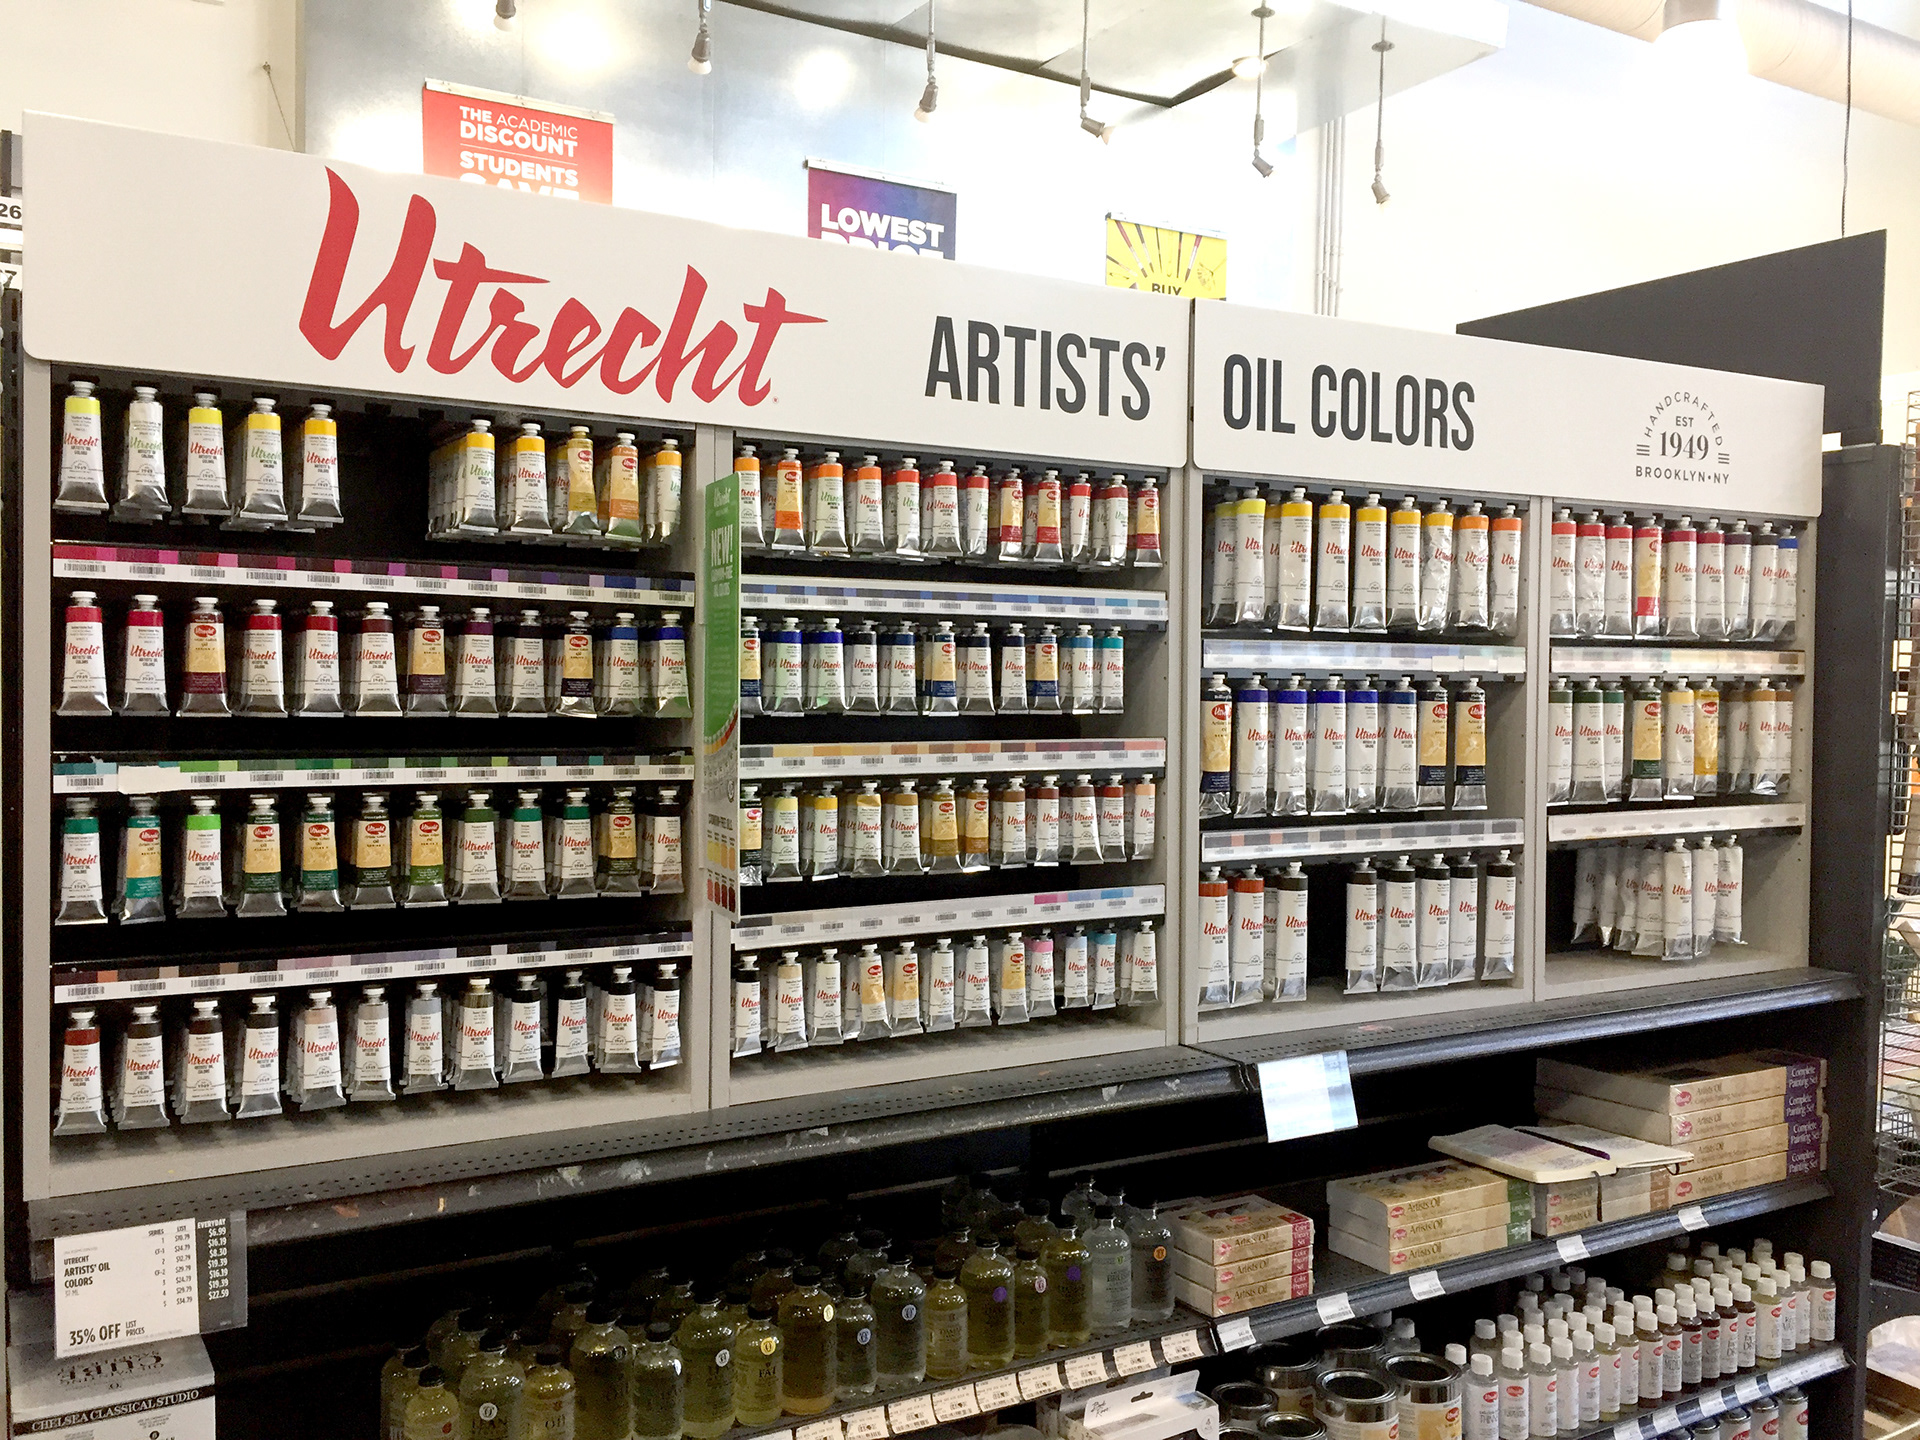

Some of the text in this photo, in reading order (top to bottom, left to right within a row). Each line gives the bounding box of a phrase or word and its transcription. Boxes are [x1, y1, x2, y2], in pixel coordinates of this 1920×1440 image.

[459, 105, 578, 139] THE ACADEMIC
[460, 120, 578, 158] DISCOUNT
[459, 150, 578, 187] STUDENTS
[821, 203, 945, 248] LOWEST
[299, 166, 828, 407] Utrecht
[925, 316, 1476, 451] ARTISTS' OIL COLORS
[1644, 391, 1723, 446] HANDCRAFTED
[1675, 415, 1694, 427] EST
[1660, 430, 1709, 460] 1949
[63, 1255, 89, 1265] UTRECHT
[98, 1262, 110, 1272] OIL
[64, 1276, 93, 1288] COLORS
[69, 1328, 96, 1346] 35%
[99, 1323, 121, 1341] OFF
[125, 1320, 137, 1329] LIST
[126, 1327, 145, 1337] PRICES
[31, 1389, 200, 1431] CHELSEA CLASSICAL STUDIO
